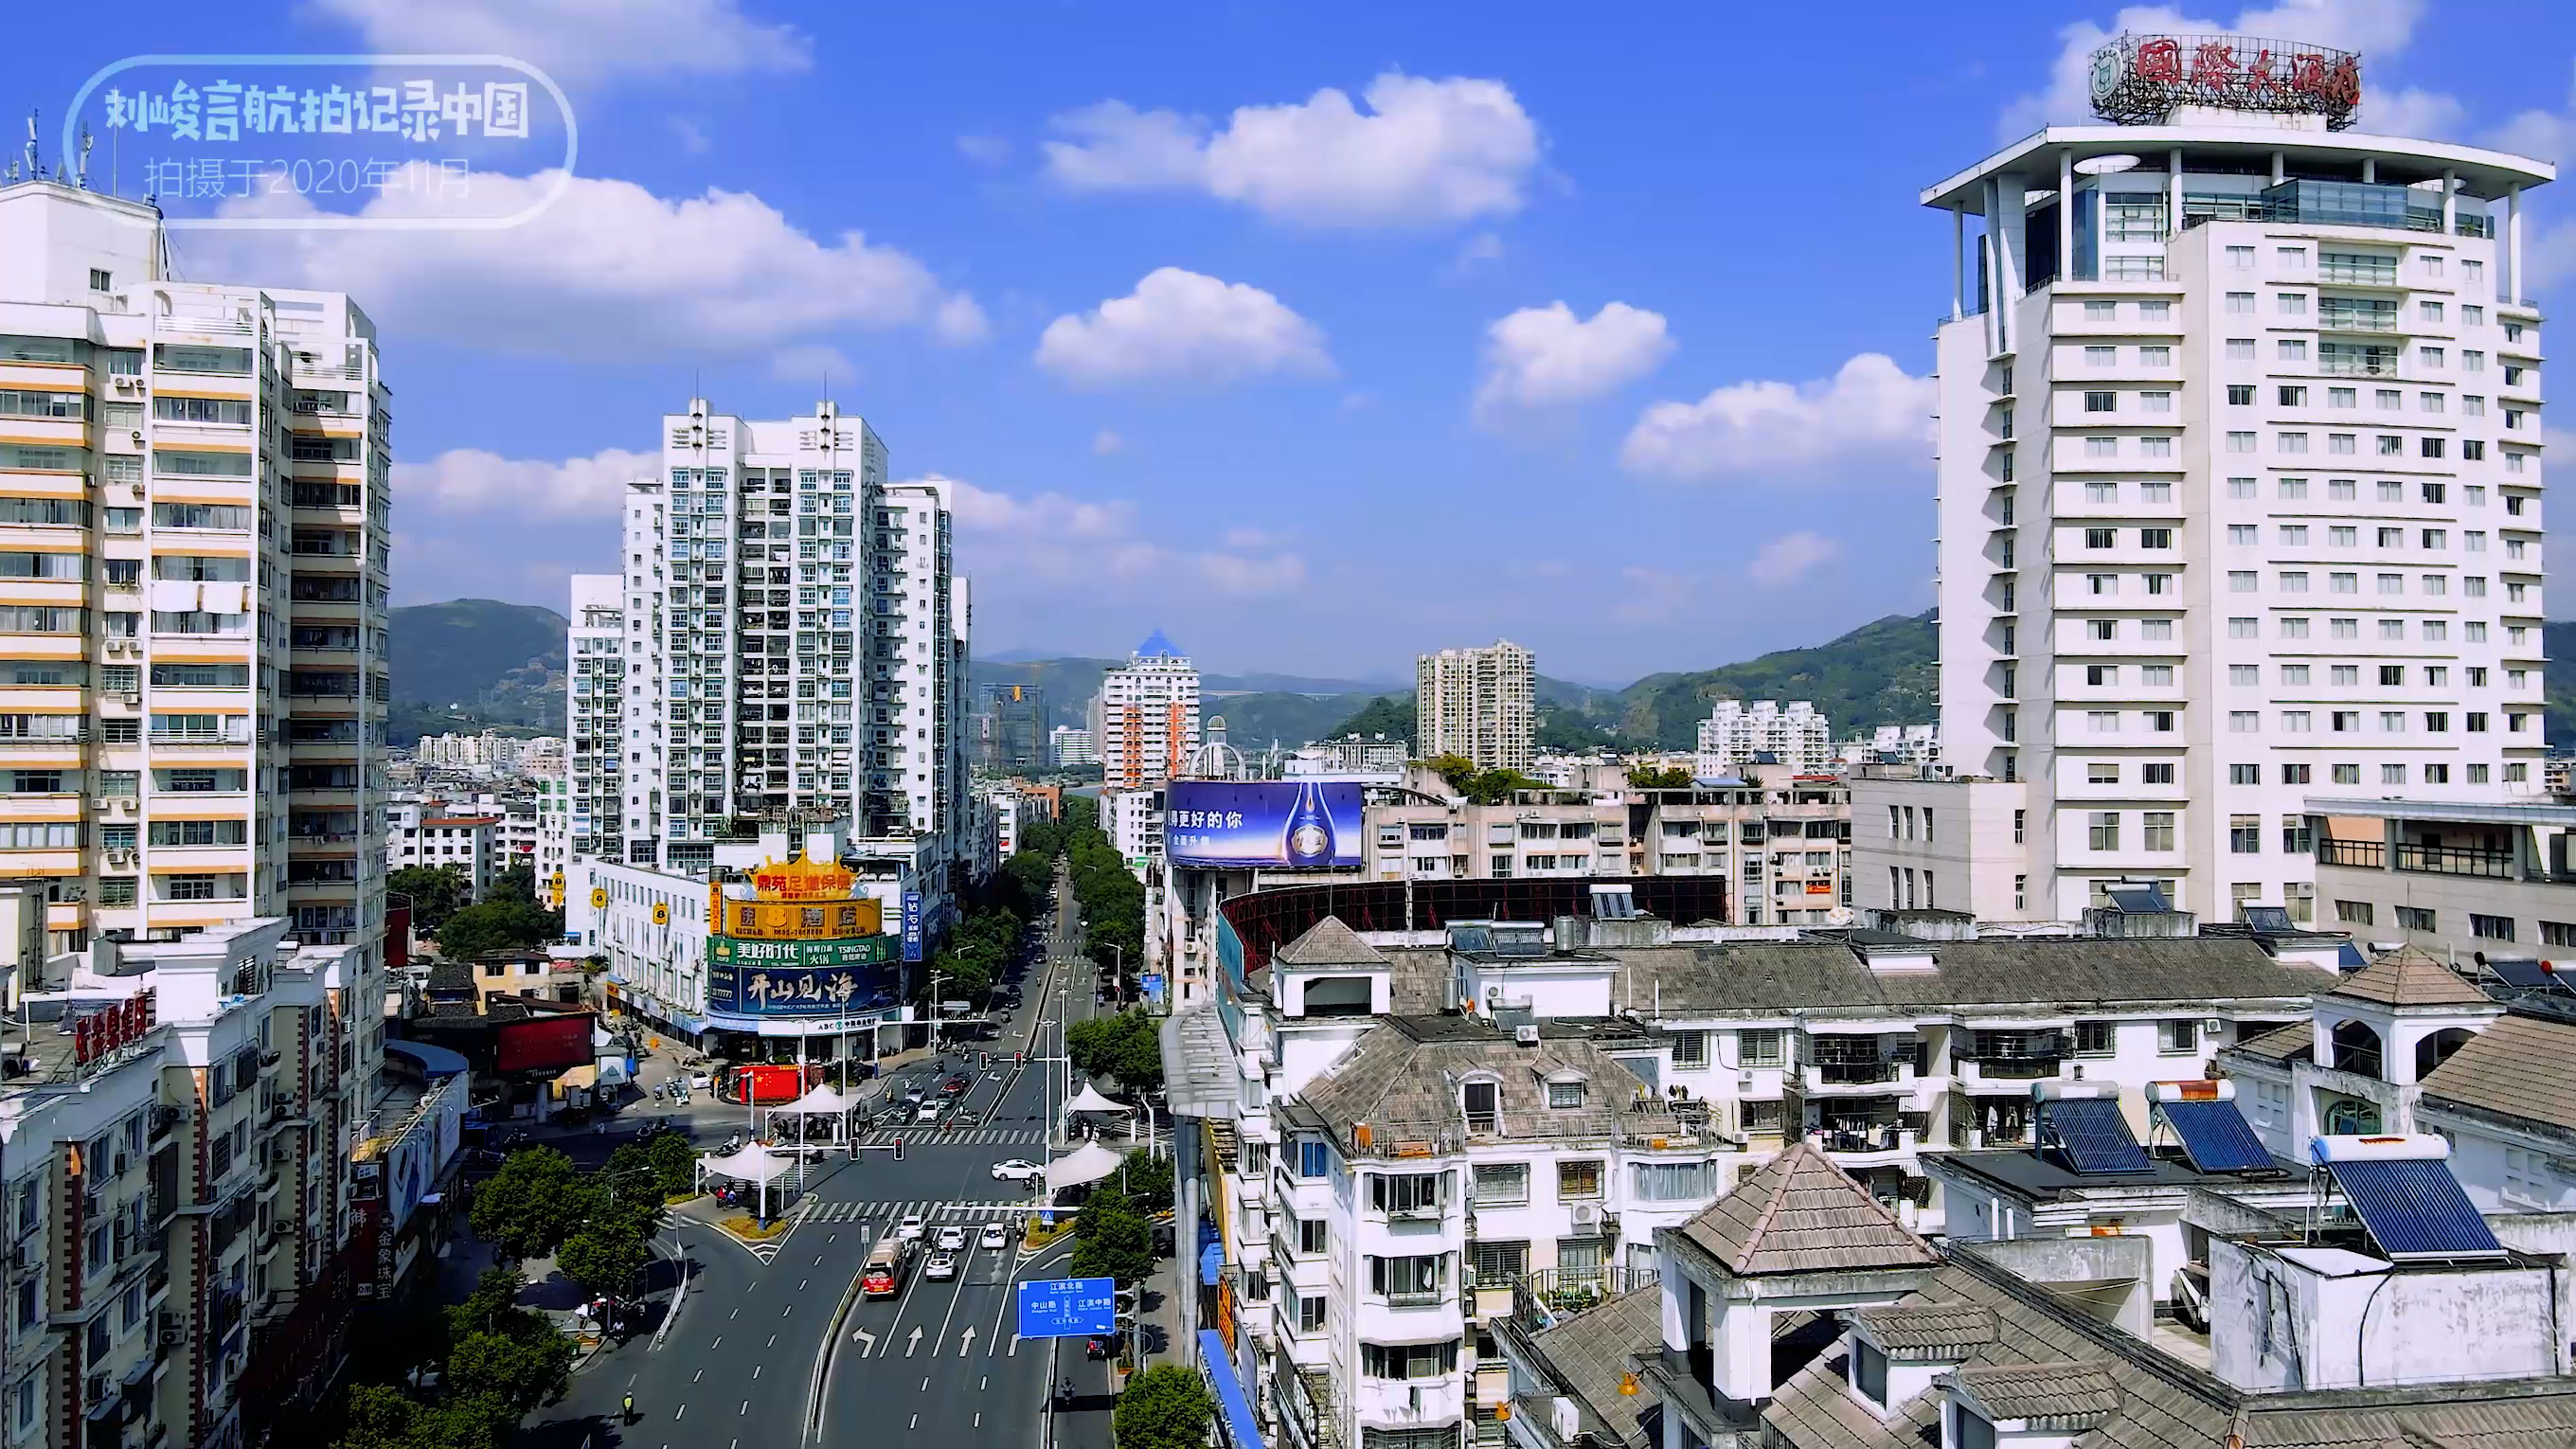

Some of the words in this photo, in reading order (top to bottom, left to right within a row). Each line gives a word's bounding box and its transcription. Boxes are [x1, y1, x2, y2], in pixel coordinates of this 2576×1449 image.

[737, 942, 799, 959] 美好时代
[747, 972, 859, 1011] 开山见海
